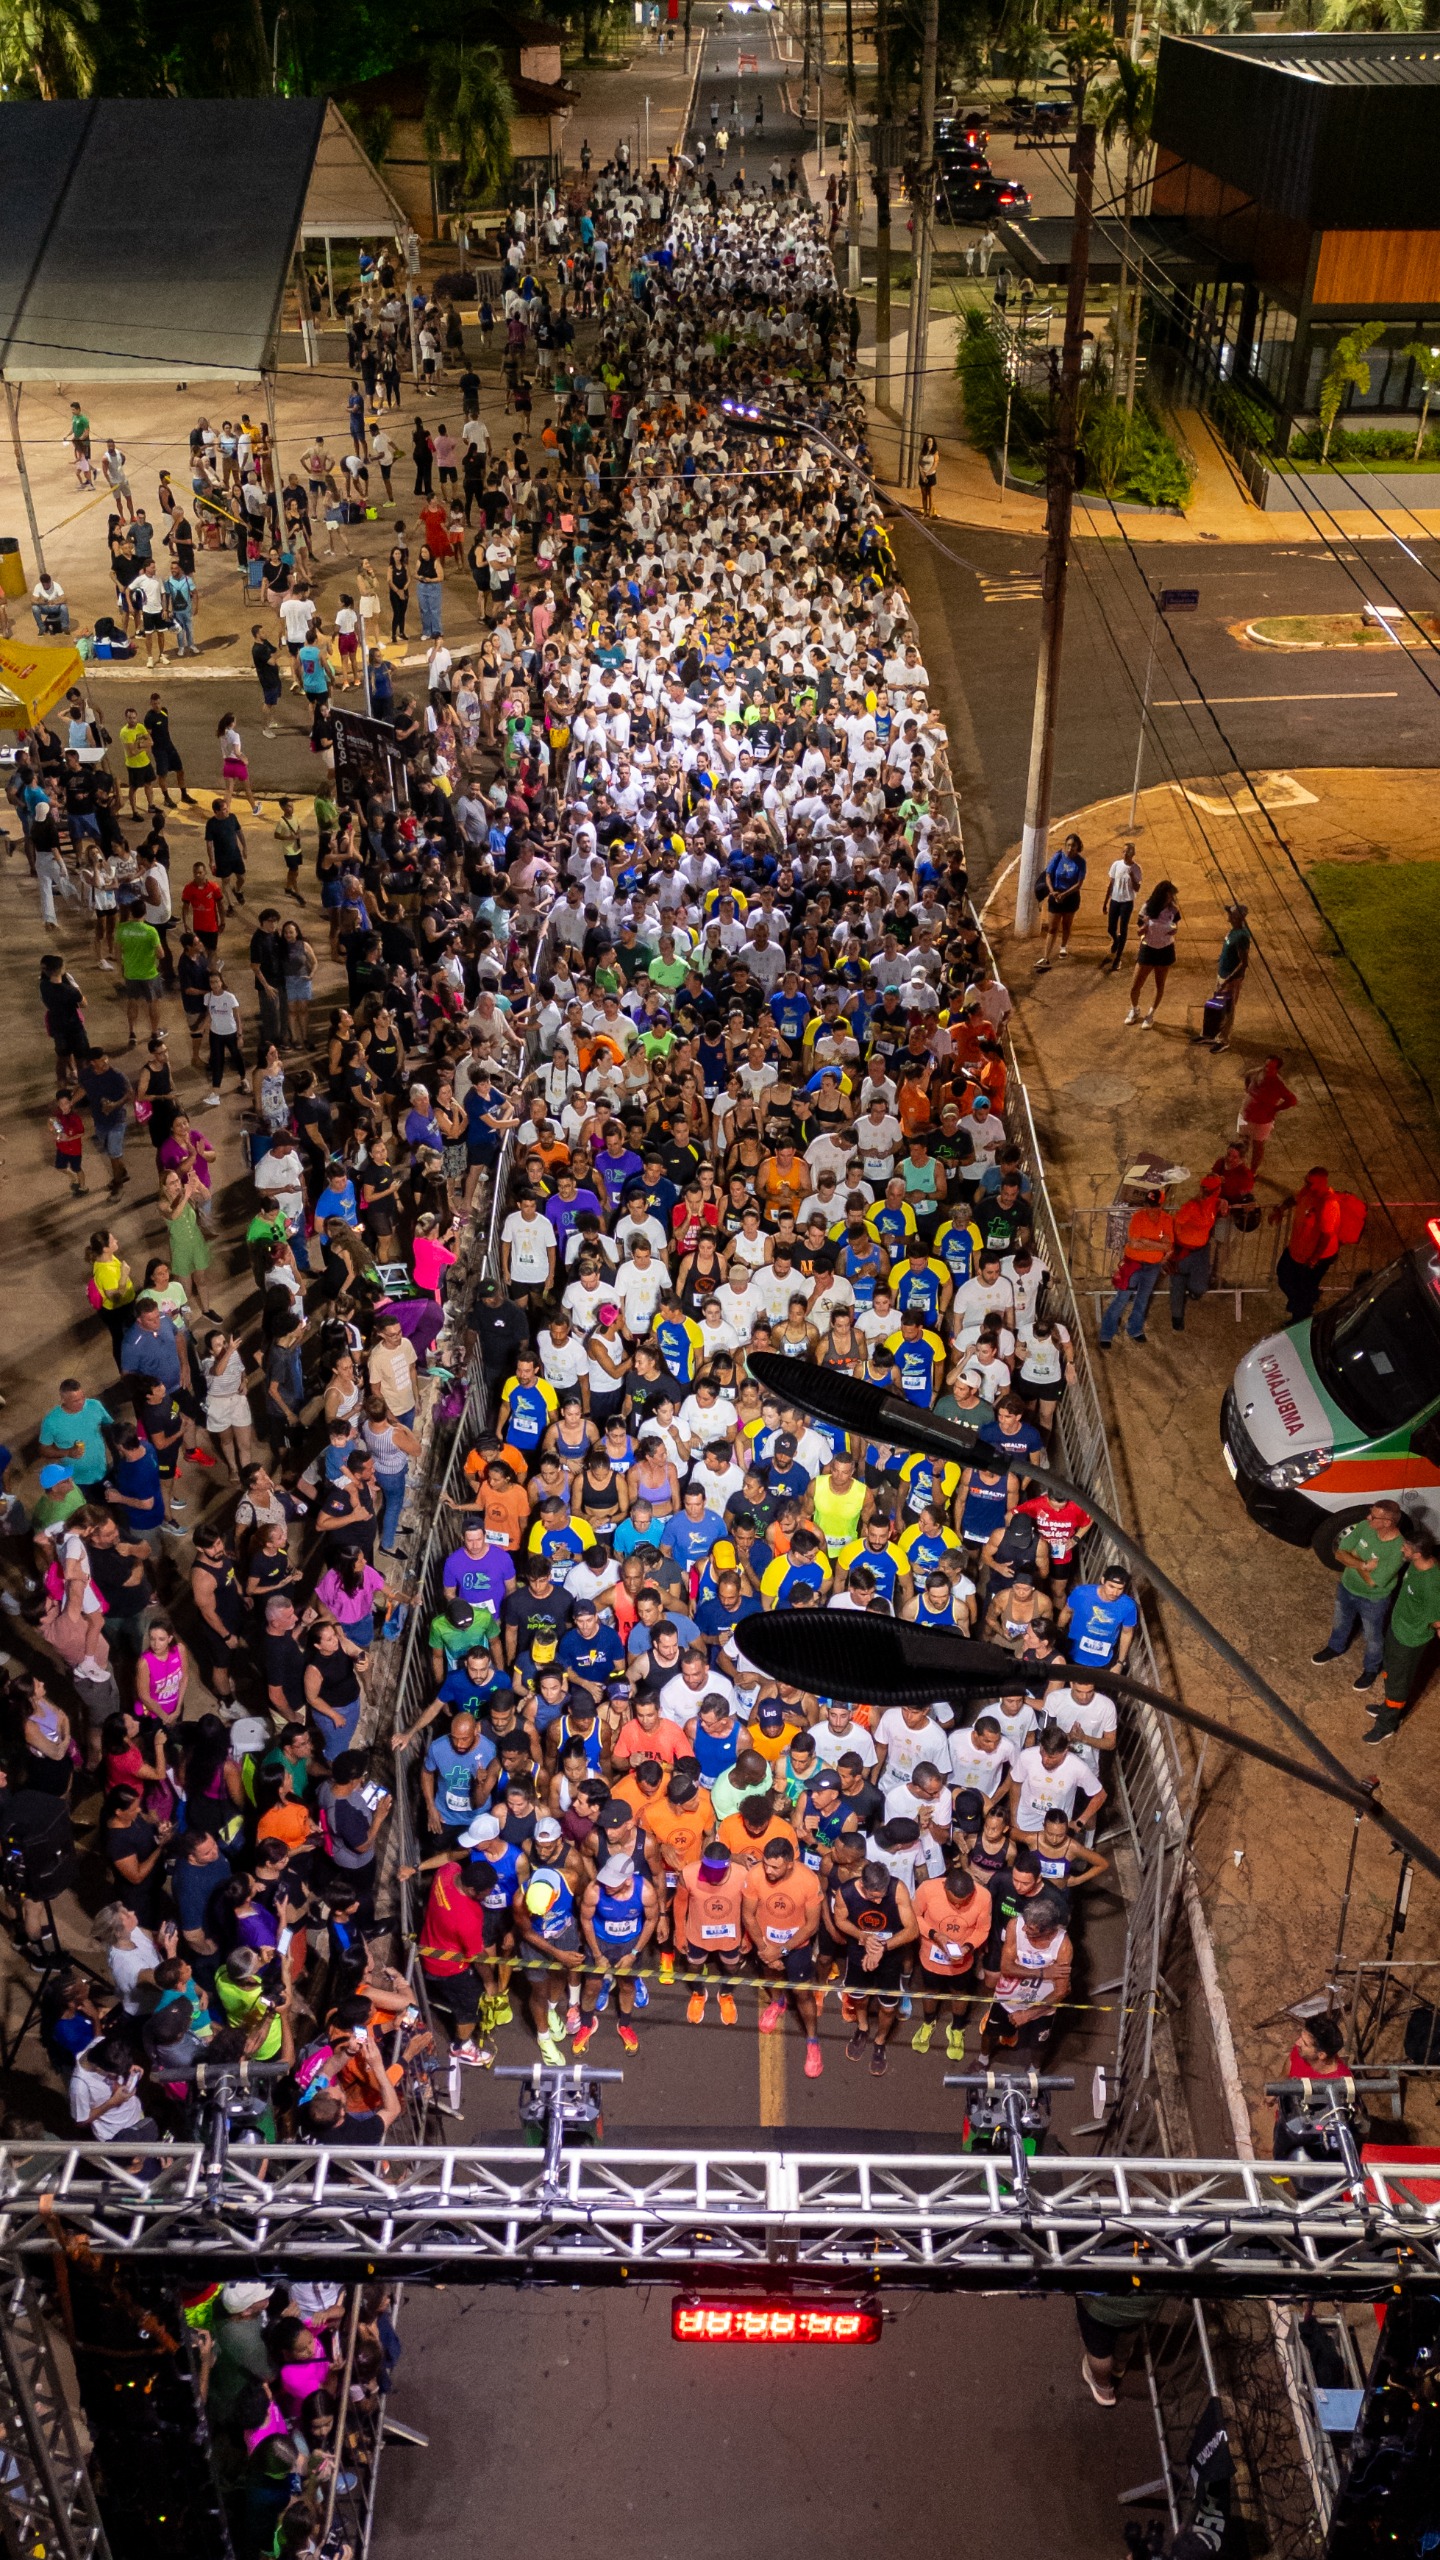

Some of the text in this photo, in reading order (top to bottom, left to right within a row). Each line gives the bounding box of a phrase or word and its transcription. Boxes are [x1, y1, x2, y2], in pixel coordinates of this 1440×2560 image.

[981, 1857, 1004, 1869] asics
[711, 1903, 724, 1911] PR
[774, 1901, 786, 1909] PR
[946, 1923, 960, 1933] PR
